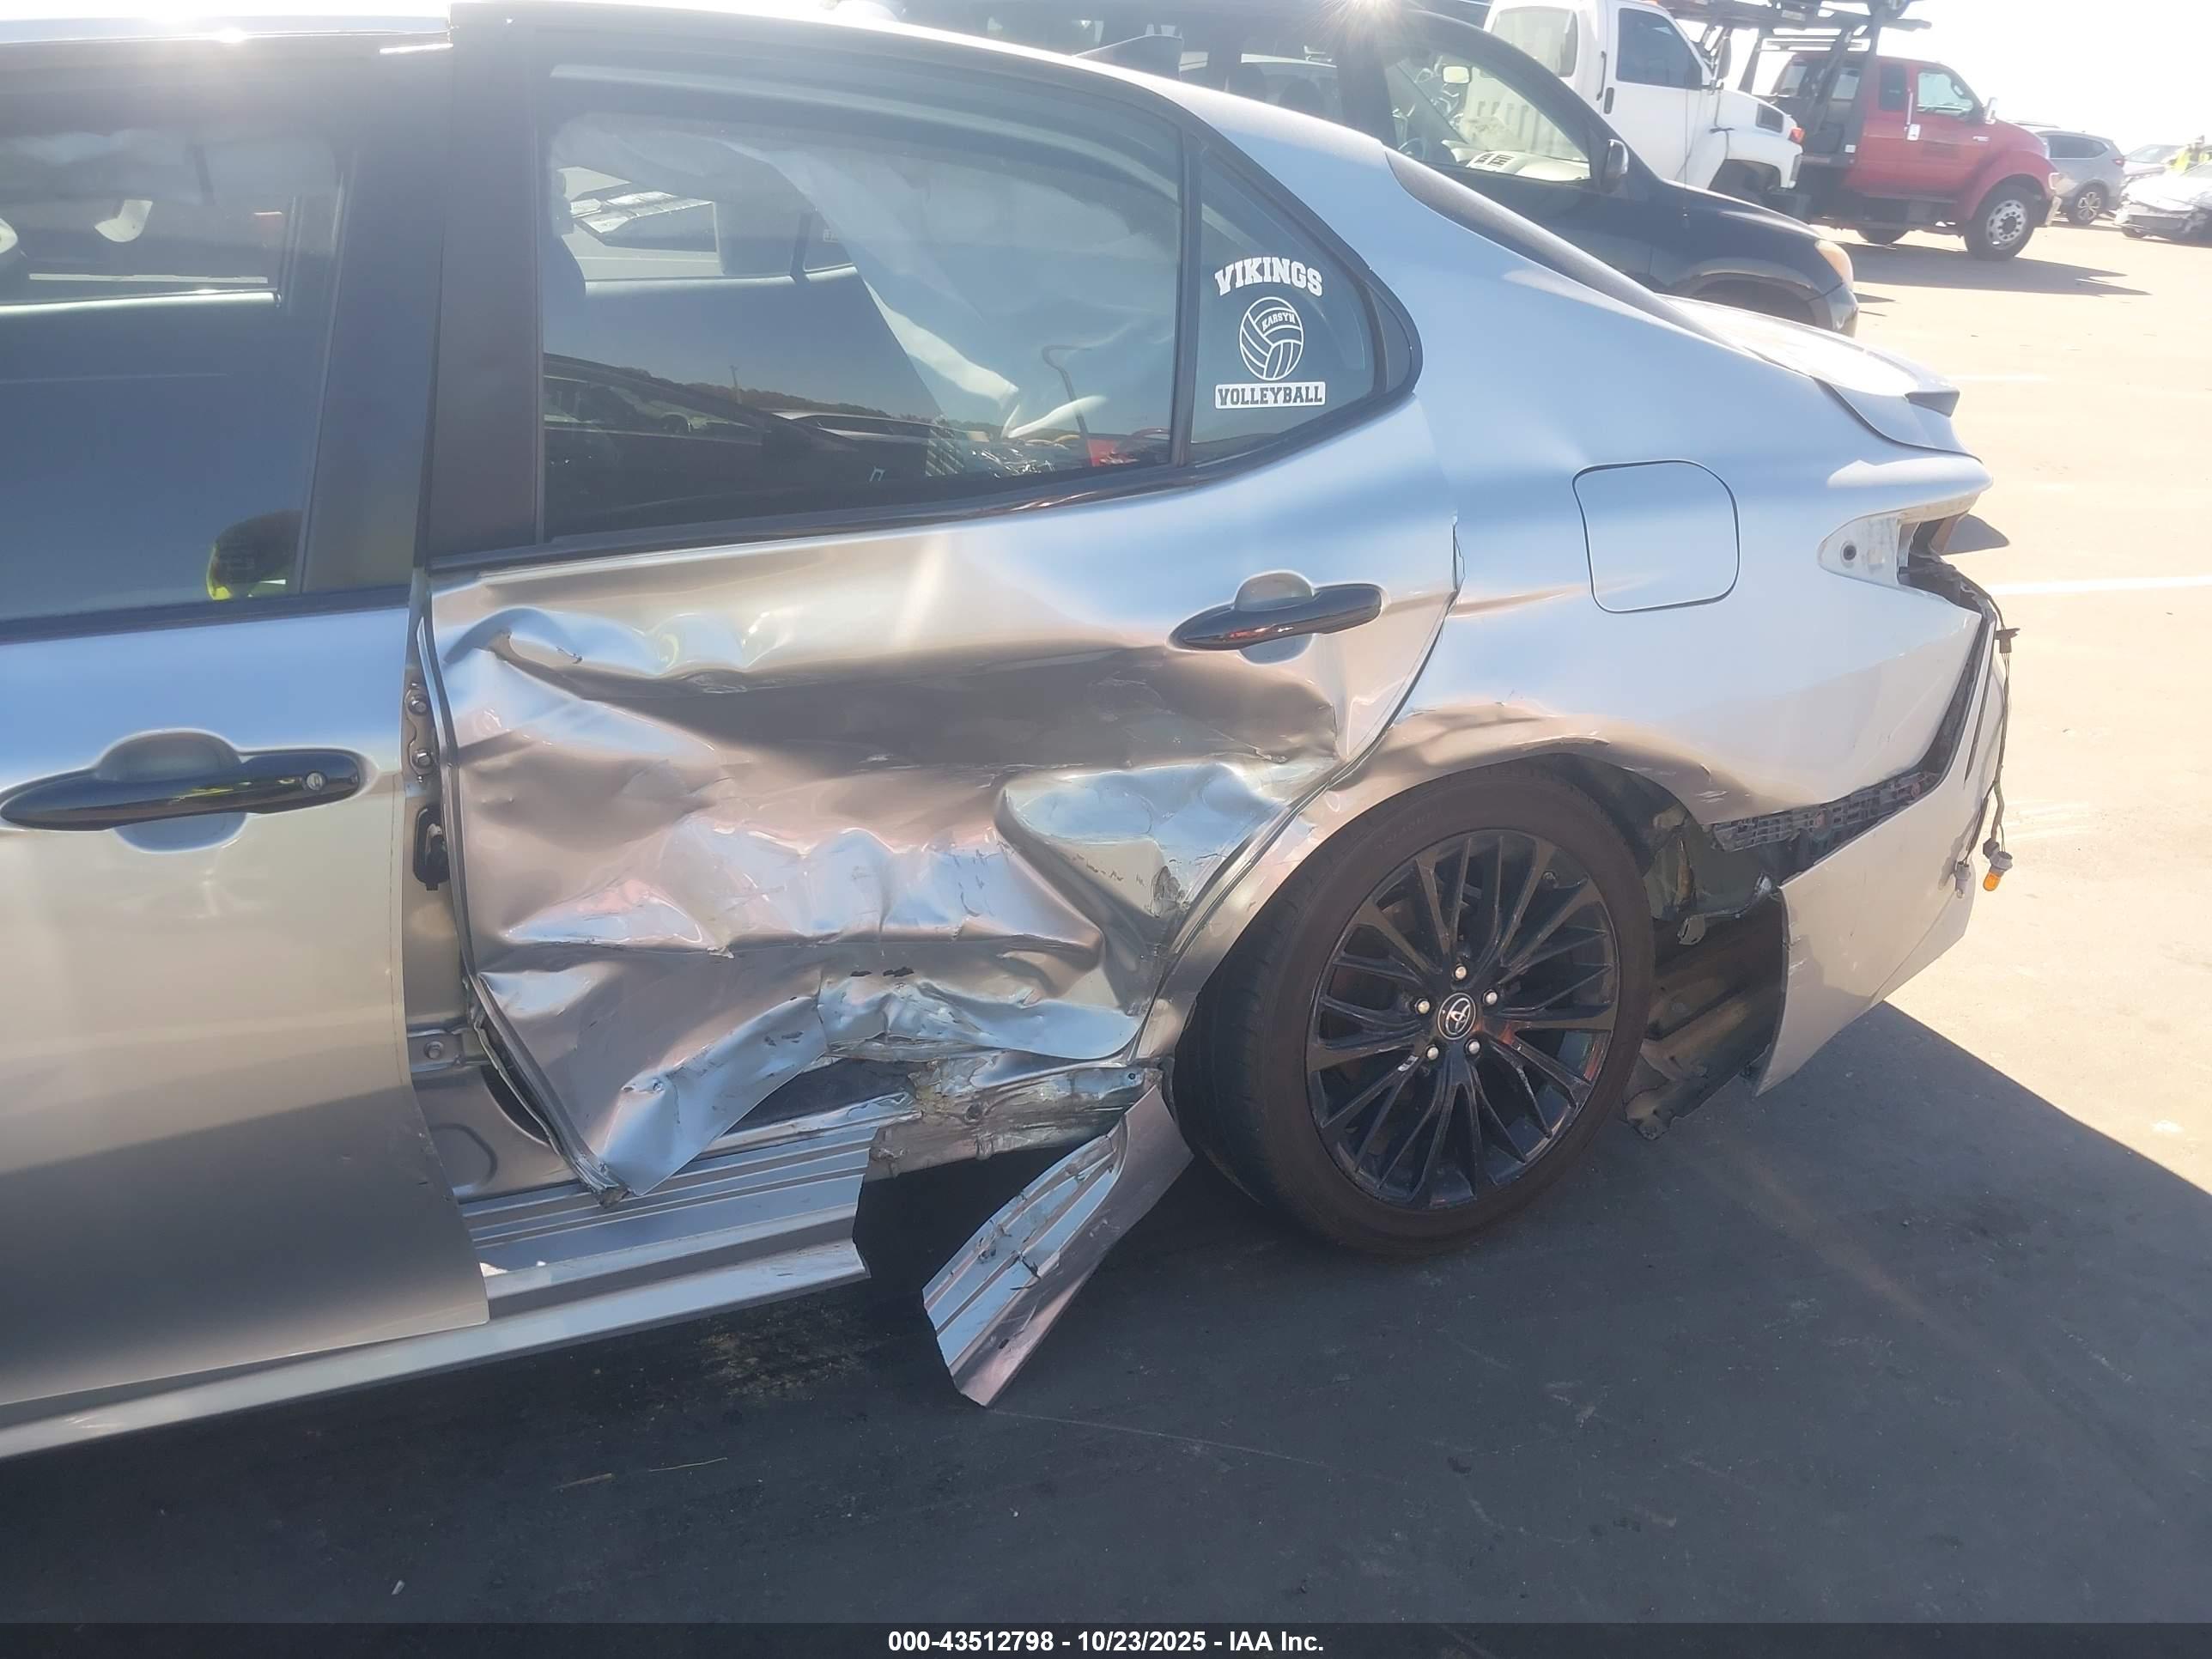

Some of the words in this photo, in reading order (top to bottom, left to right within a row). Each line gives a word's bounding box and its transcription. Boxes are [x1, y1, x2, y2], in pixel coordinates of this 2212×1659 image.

[1215, 257, 1322, 296] VIKINGS
[1261, 312, 1296, 331] KARSYN
[1218, 386, 1322, 406] VOLLEYBALL
